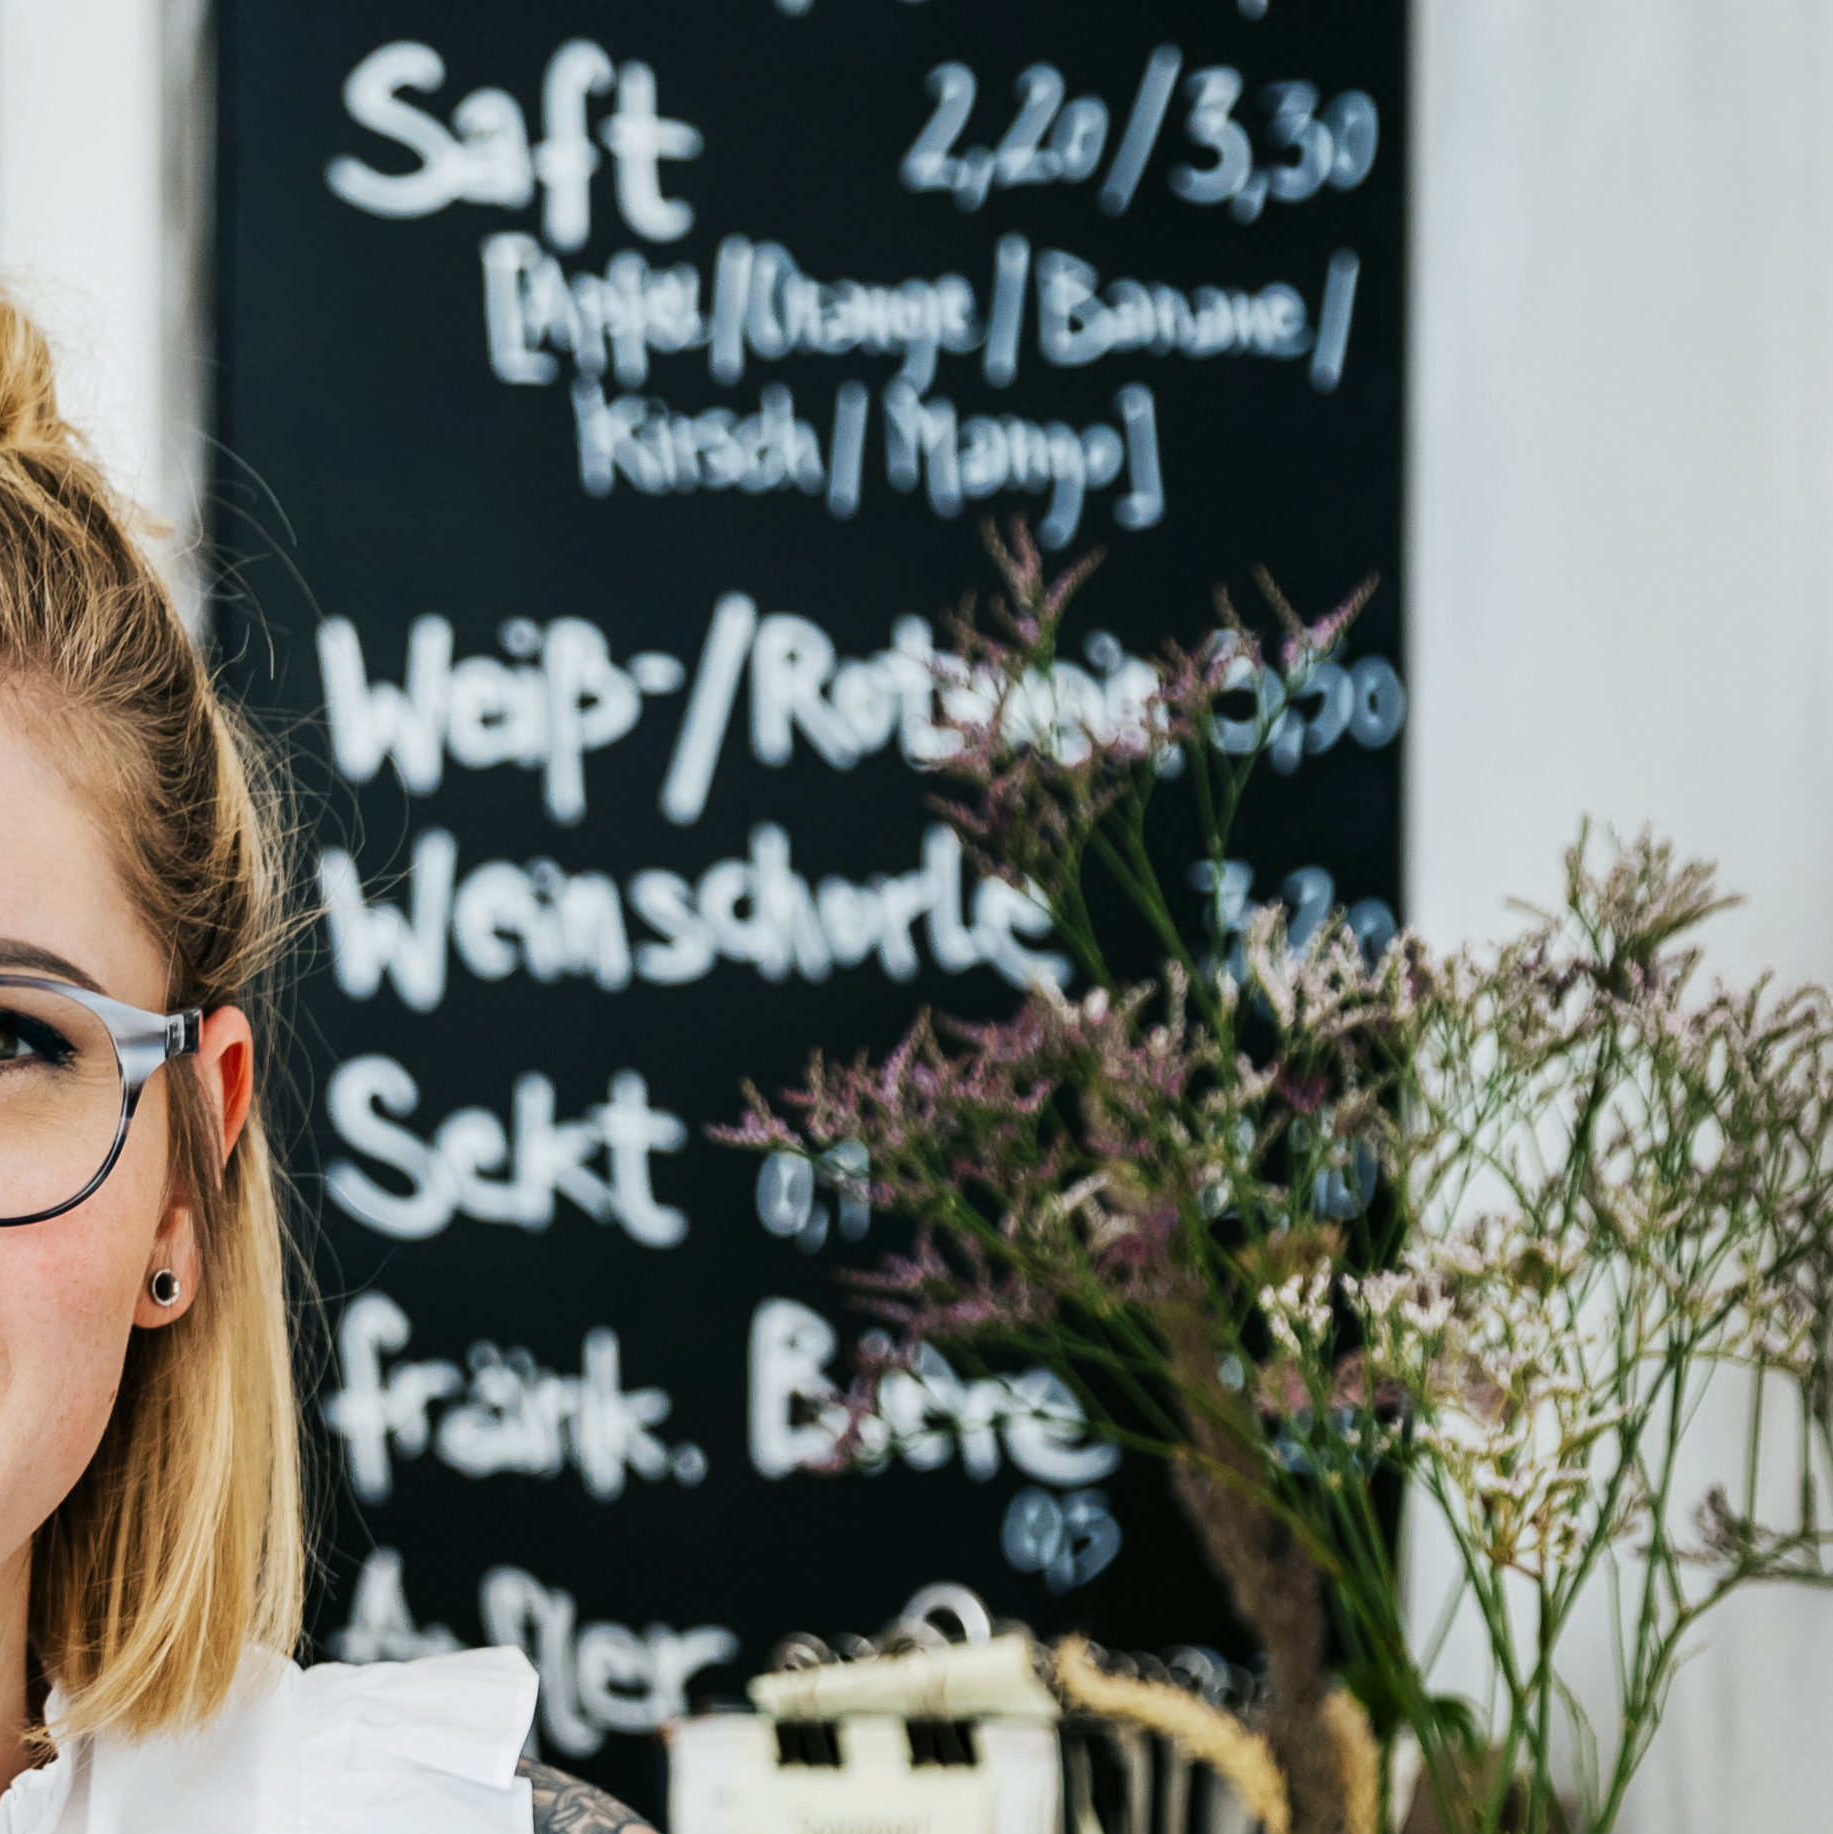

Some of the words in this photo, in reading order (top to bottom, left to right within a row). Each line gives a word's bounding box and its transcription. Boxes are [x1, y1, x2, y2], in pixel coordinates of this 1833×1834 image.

[328, 40, 704, 248] Saft
[901, 44, 1377, 222] 2,20/3,30
[323, 825, 1075, 1010] Weinschorle
[329, 1054, 687, 1246] Sekt
[331, 1292, 708, 1502] fränk.
